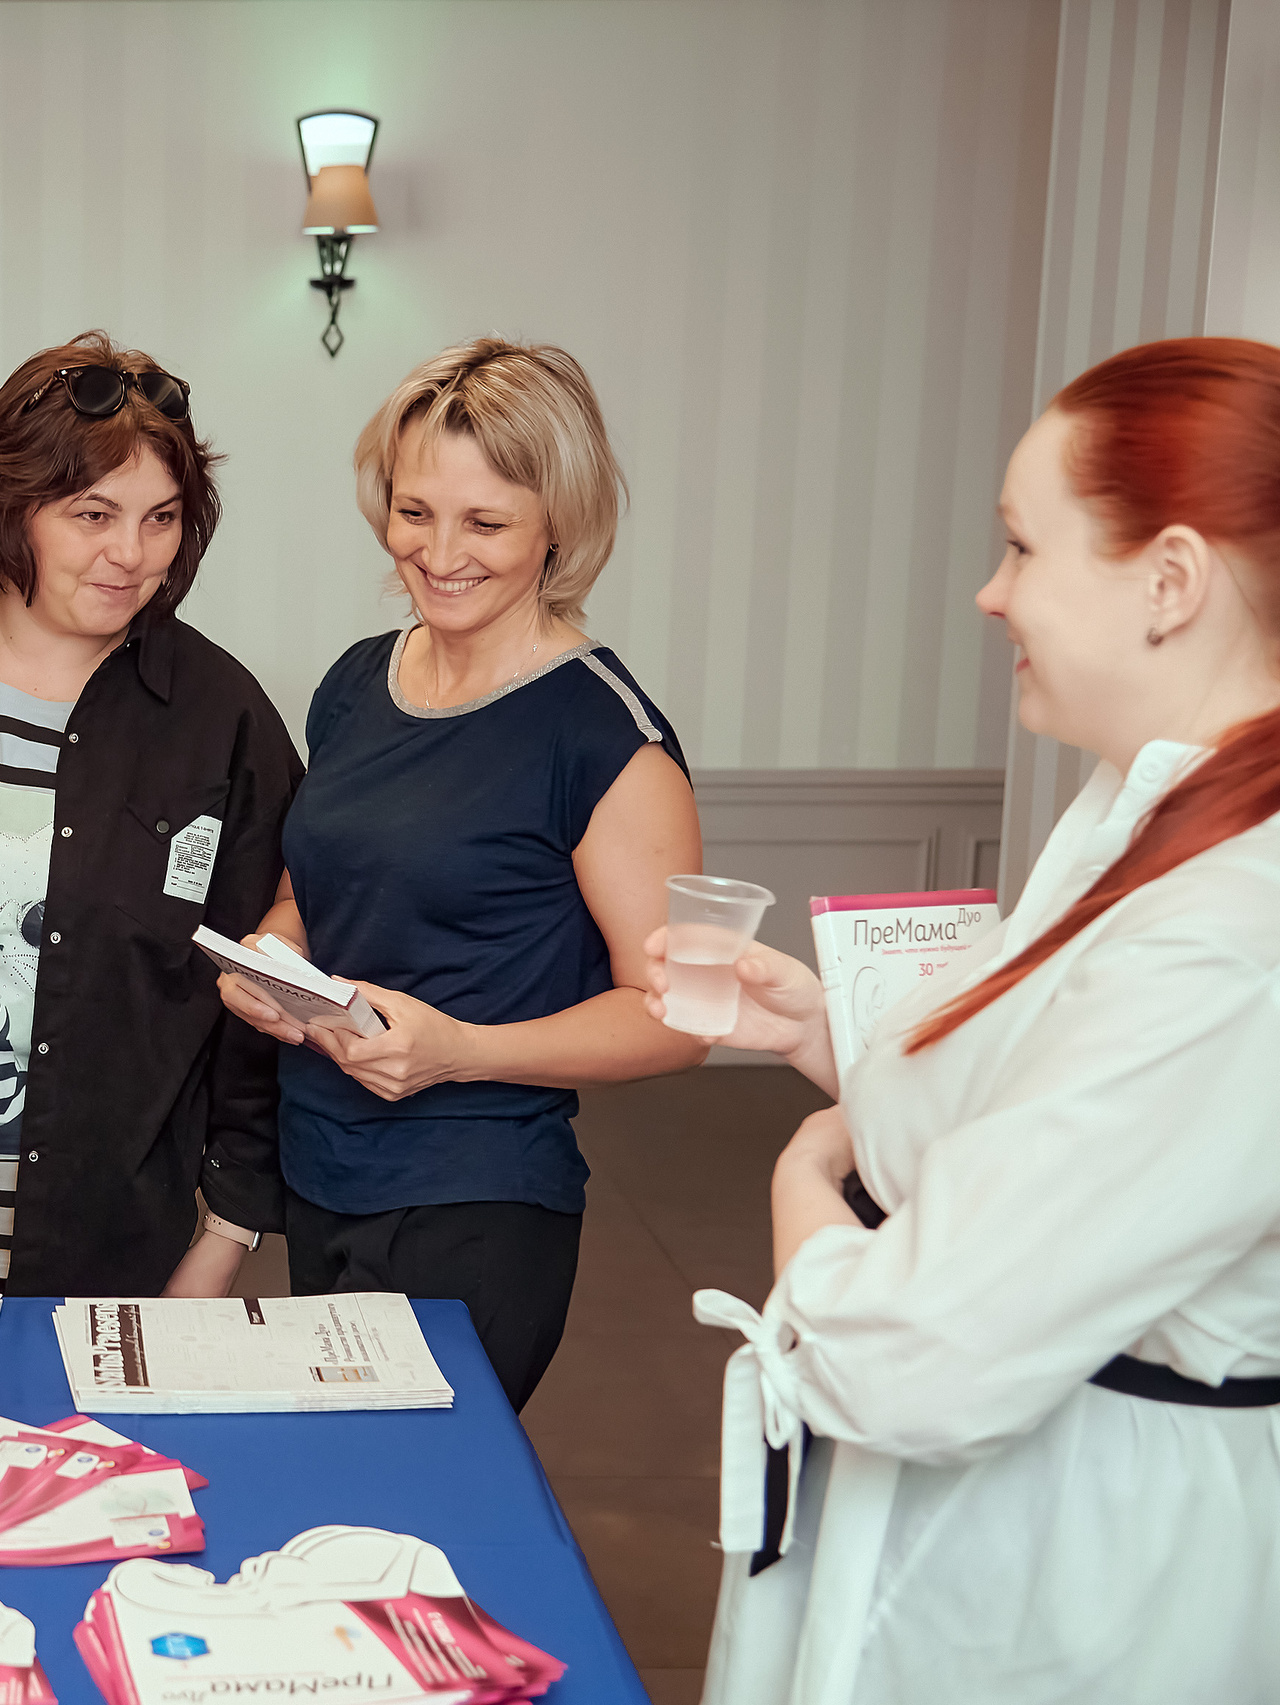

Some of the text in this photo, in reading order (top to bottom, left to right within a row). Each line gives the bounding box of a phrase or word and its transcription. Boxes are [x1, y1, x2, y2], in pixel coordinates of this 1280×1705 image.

[854, 908, 981, 952] ПреМама Дуо
[918, 962, 934, 977] 30
[210, 1672, 393, 1695] ПреМама
